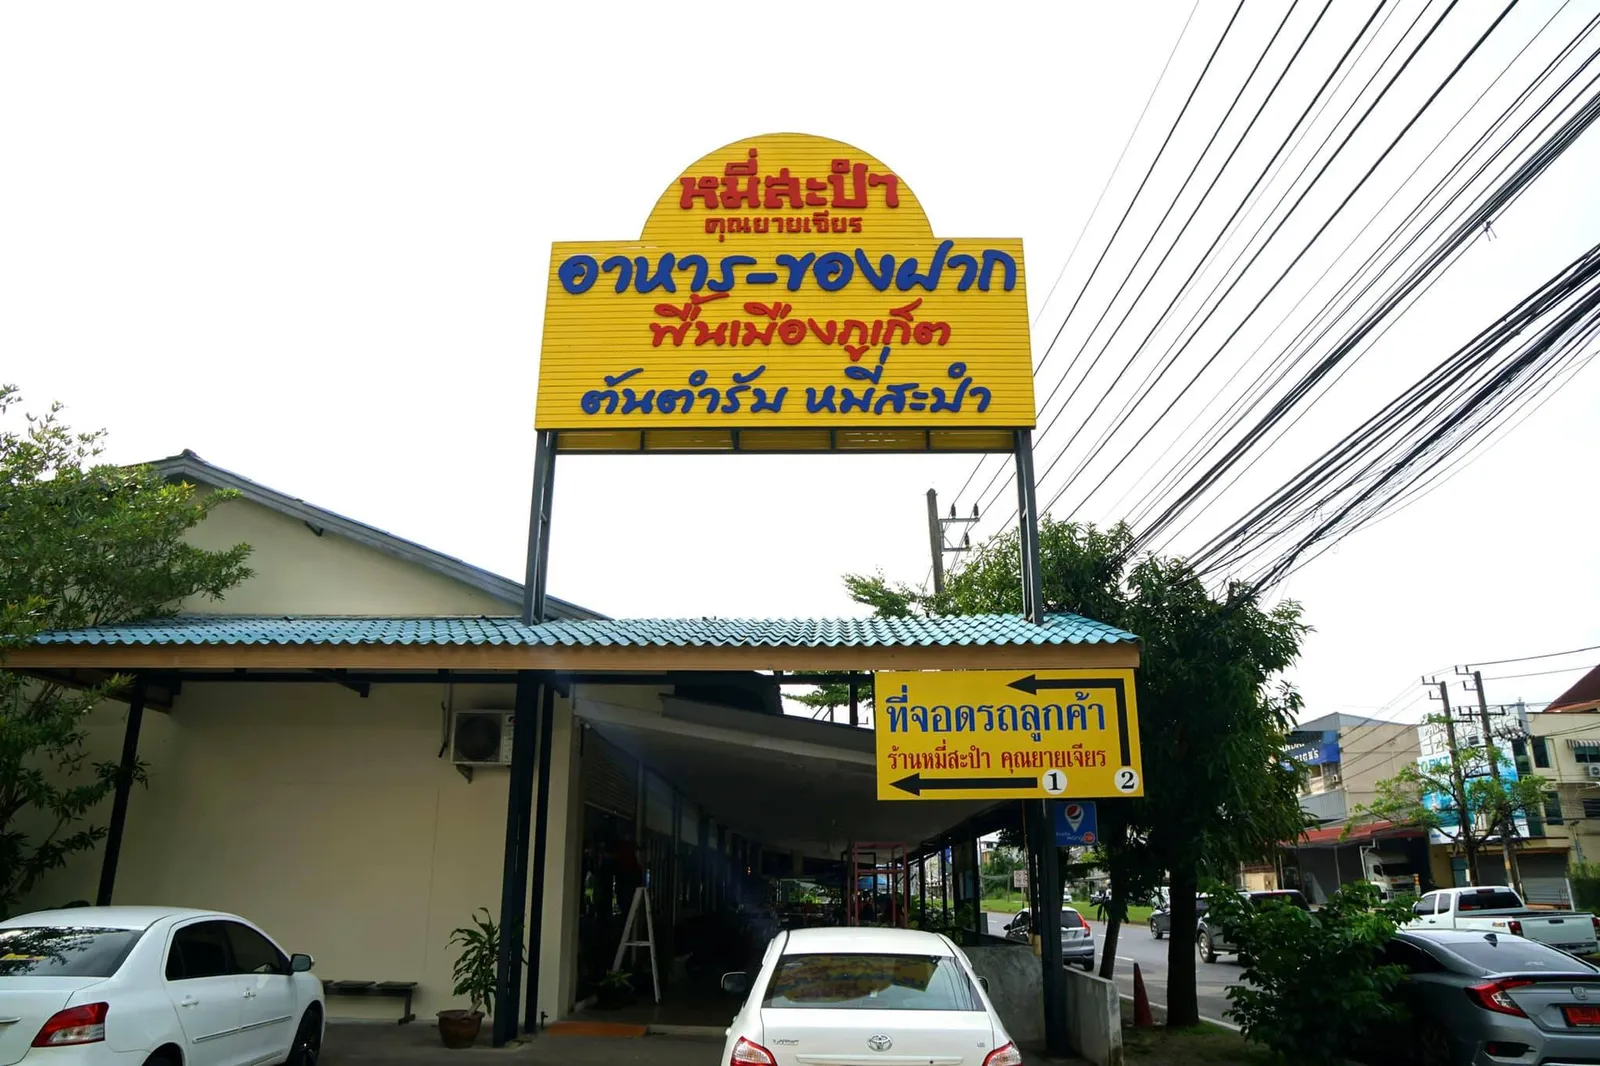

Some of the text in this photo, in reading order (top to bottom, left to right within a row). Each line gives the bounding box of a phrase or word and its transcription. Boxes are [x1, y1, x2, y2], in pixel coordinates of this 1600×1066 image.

[680, 148, 899, 209] หมี่สะปำ
[705, 210, 862, 243] คุณยายเจียร
[558, 240, 1016, 294] อาหาร-ของฝาก
[650, 292, 951, 361] พื้นเมืองภูเก็ต
[581, 347, 992, 414] ต้นตำรับ หมี่สะปำ
[886, 685, 1105, 742] ที่จอดรถลูกค้า
[887, 739, 1106, 773] ร้านหมี่สะปำ คุณยายเจียร
[1048, 773, 1061, 790] 1
[1121, 771, 1134, 789] 2
